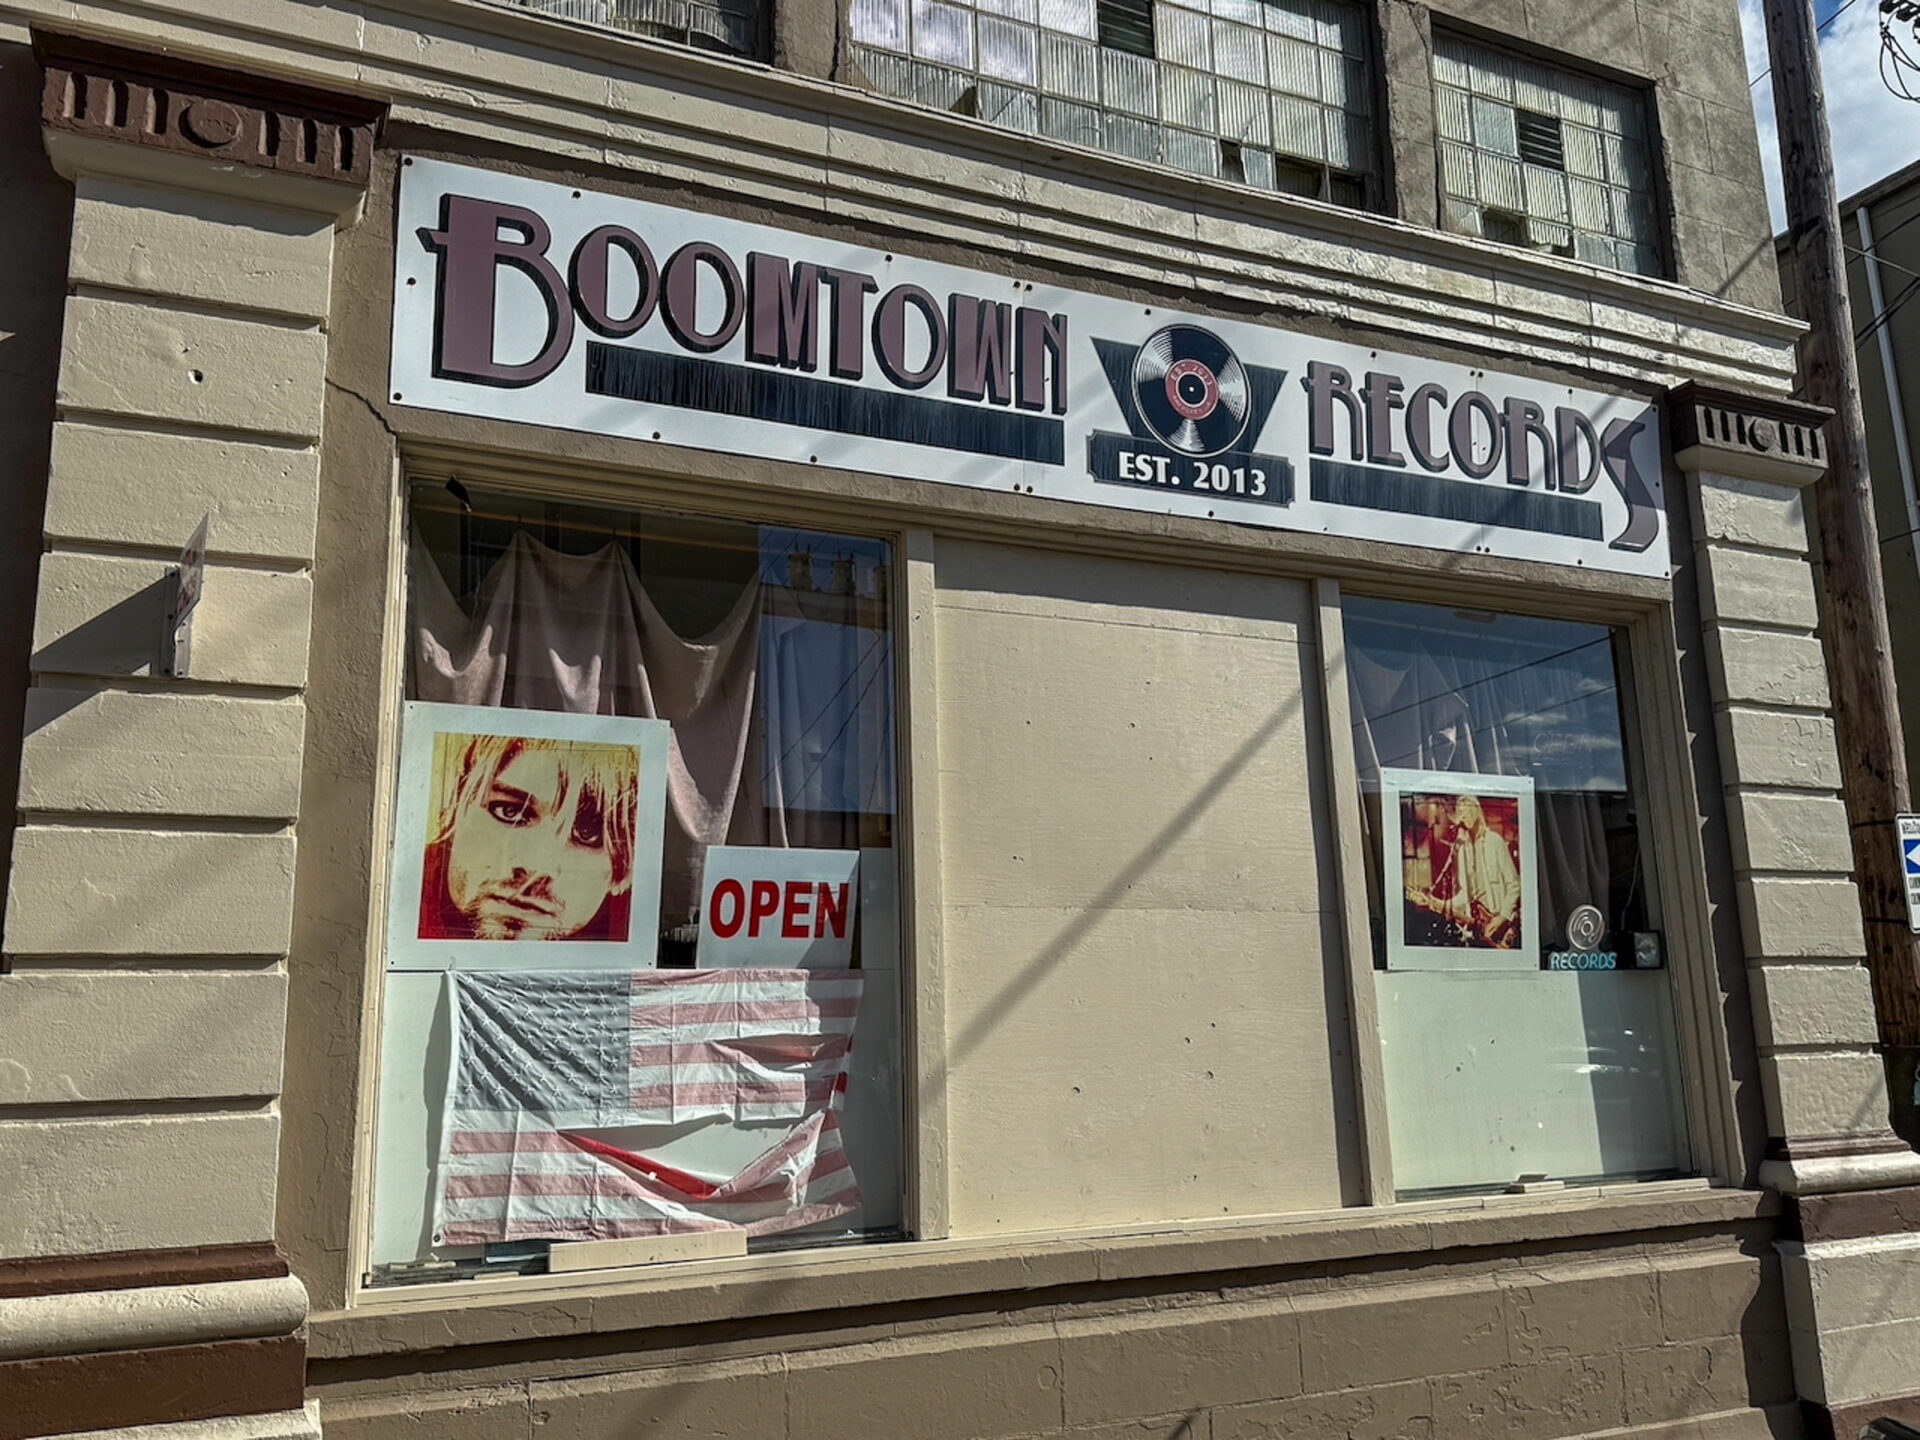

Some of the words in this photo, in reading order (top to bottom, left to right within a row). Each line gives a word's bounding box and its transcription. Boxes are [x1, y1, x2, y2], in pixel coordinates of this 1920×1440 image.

[415, 192, 1068, 415] BOOMTOWN
[1300, 360, 1661, 552] RECORDS
[1118, 451, 1181, 486] EST.
[1193, 461, 1267, 496] 2013
[709, 878, 850, 940] OPEN
[1550, 951, 1618, 969] RECORDS
